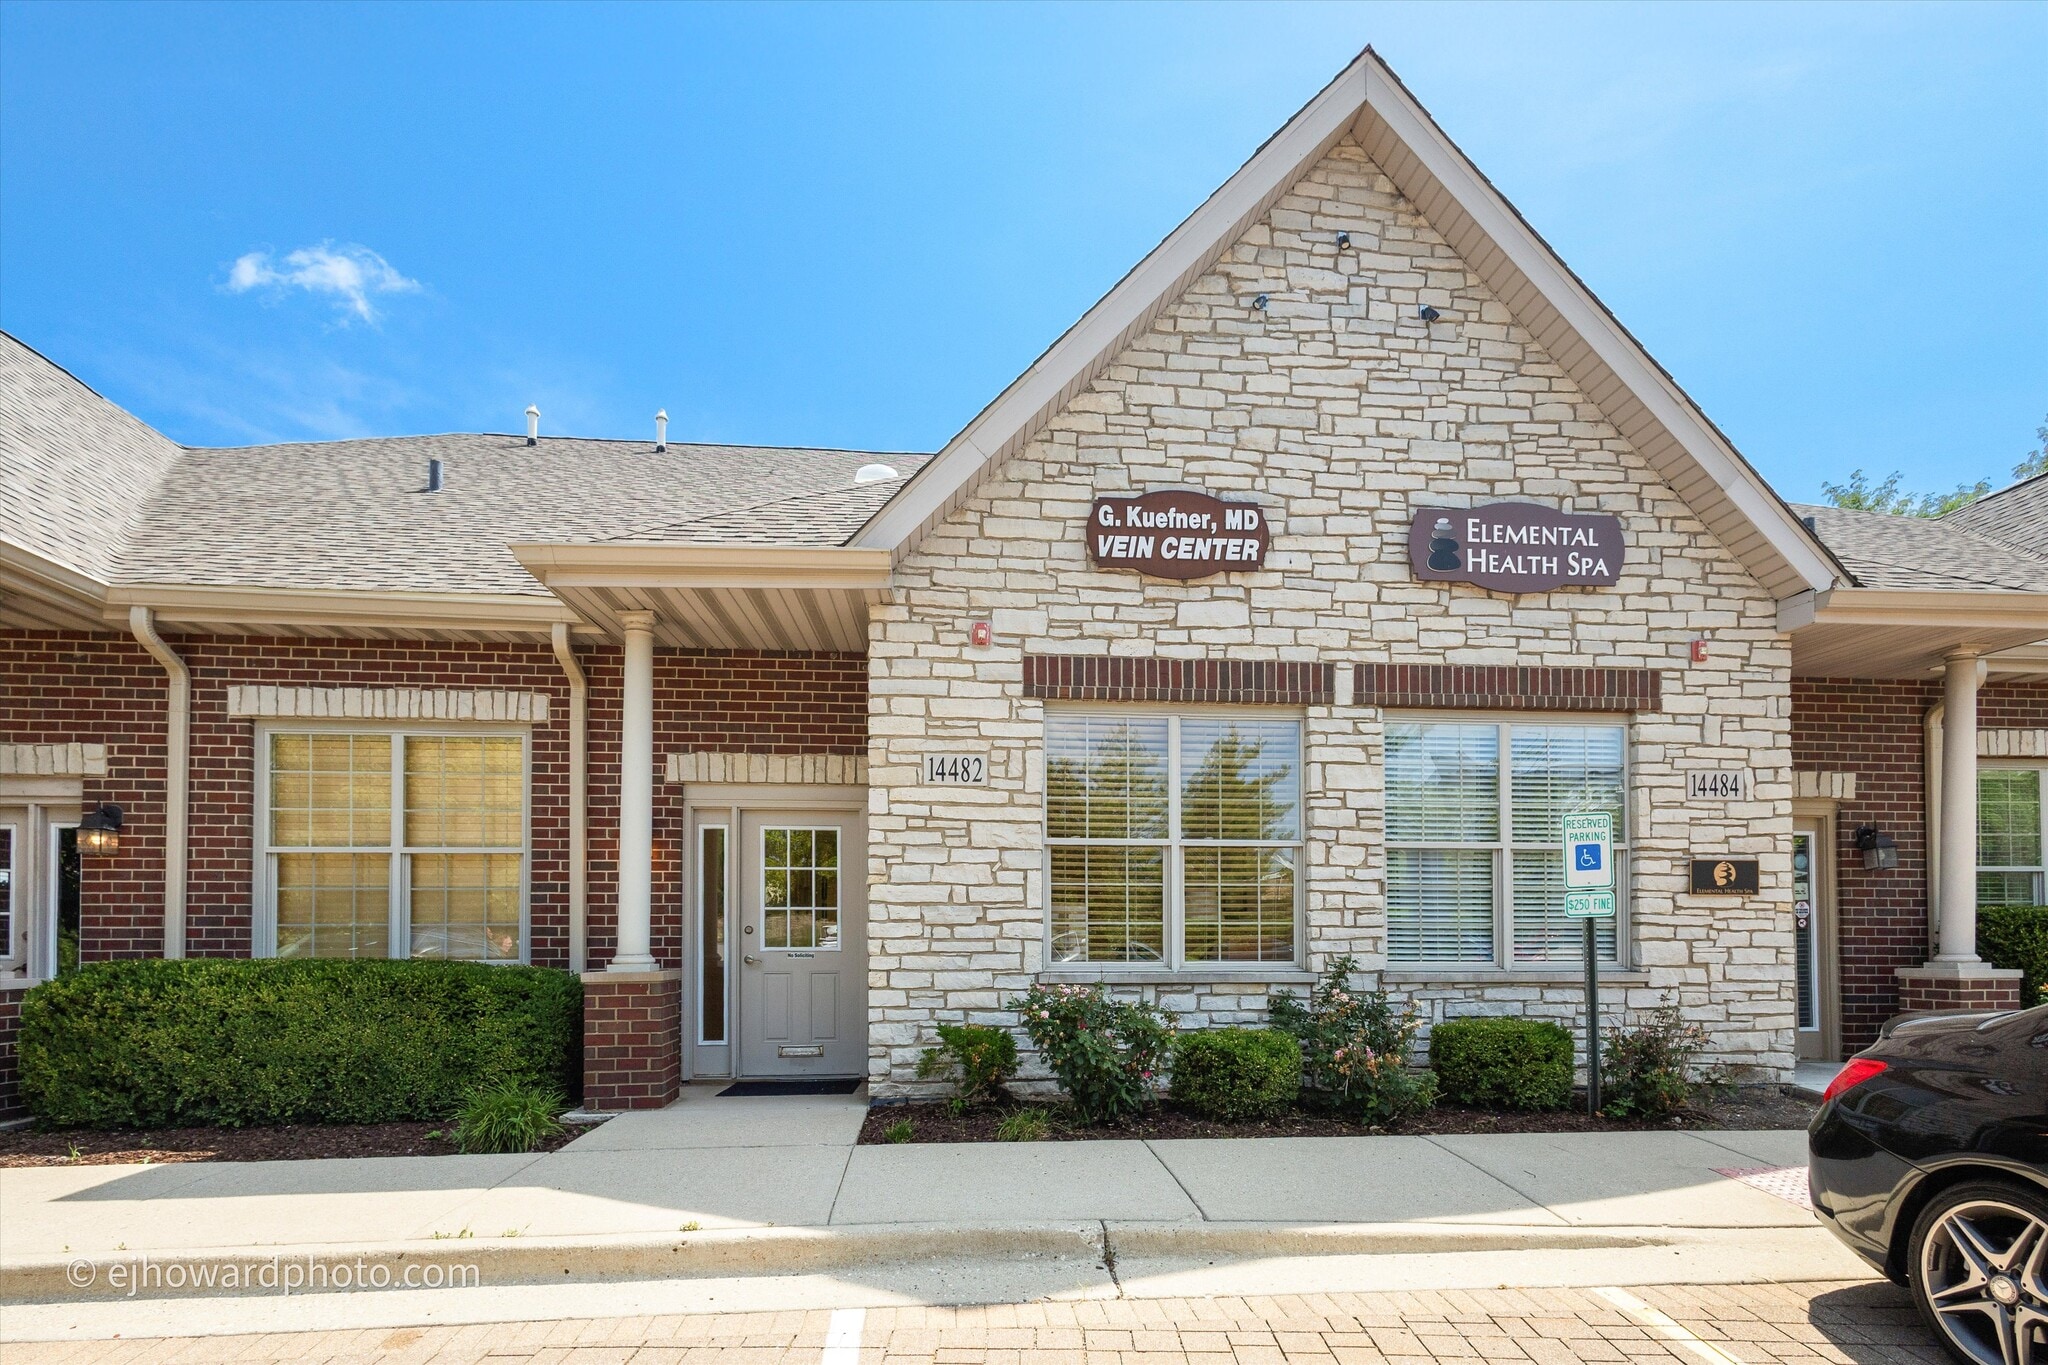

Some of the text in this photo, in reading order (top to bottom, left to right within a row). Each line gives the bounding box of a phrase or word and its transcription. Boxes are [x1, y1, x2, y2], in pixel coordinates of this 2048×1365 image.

[1098, 504, 1259, 534] G. Kuefner, MD
[1467, 518, 1599, 547] ELEMENTAL
[1098, 535, 1260, 561] VEIN CENTER
[1467, 548, 1610, 577] HEALTH SPA
[928, 757, 983, 783] 14482
[1691, 773, 1739, 797] 14484
[1566, 818, 1608, 829] RESERVED
[1569, 831, 1606, 842] PARKING
[1568, 898, 1611, 910] $250 FINE
